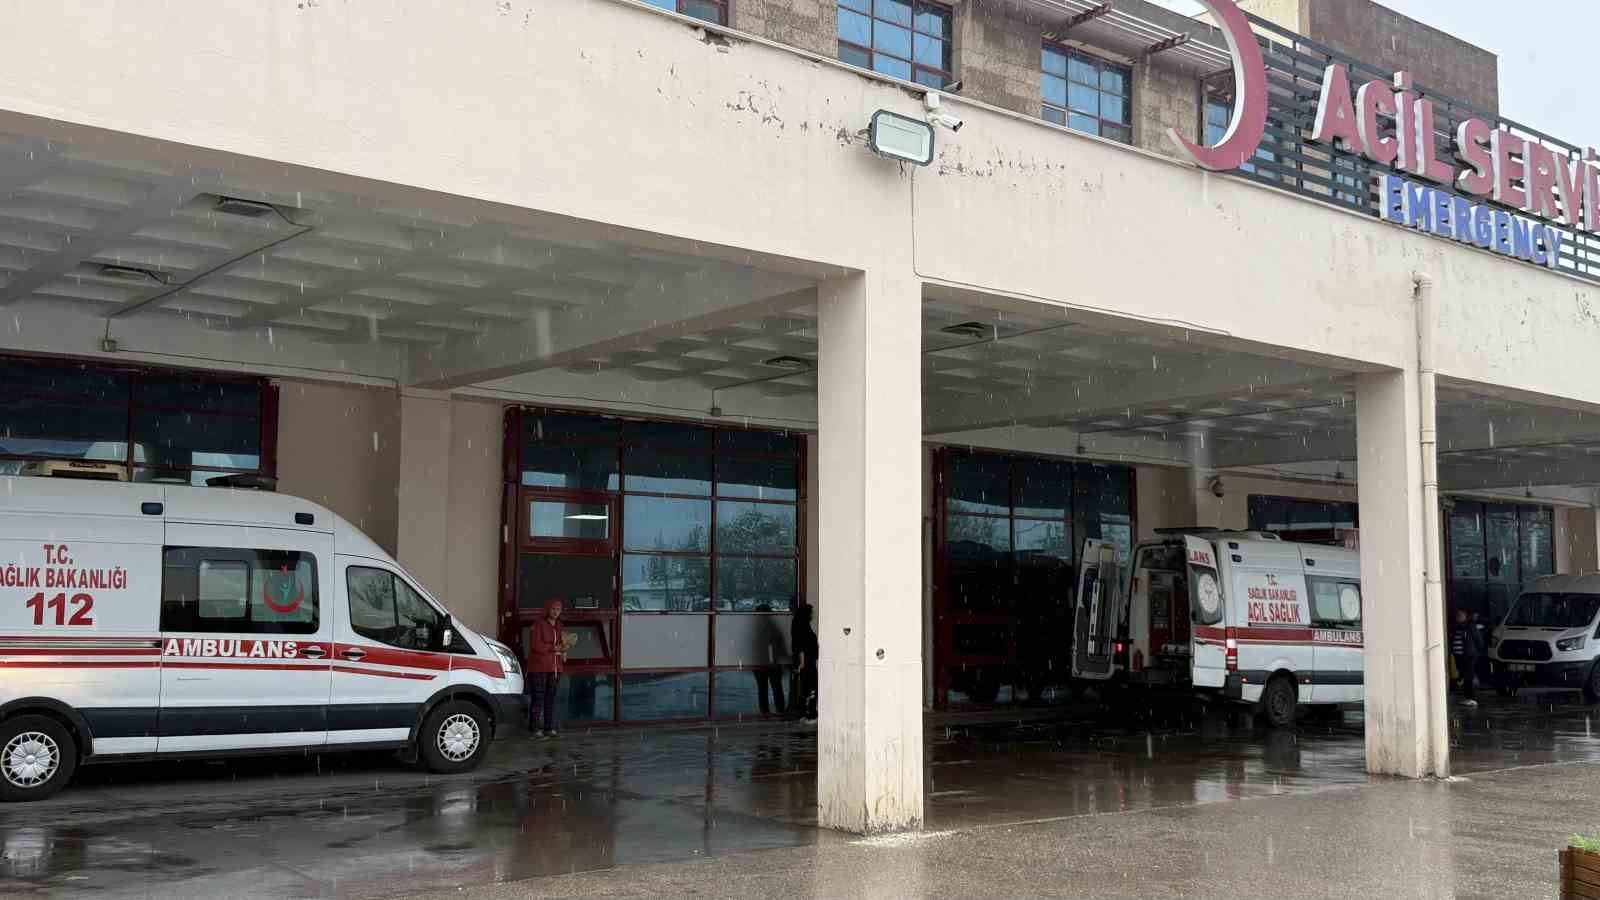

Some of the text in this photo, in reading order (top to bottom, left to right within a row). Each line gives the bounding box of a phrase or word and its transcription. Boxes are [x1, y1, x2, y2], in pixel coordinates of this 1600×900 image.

[1312, 64, 1455, 184] ACİL
[1379, 176, 1563, 269] EMERGENCY
[43, 544, 74, 565] T.C.
[45, 566, 127, 589] BAKANLIĞI
[26, 592, 94, 626] 112
[163, 638, 298, 658] AMBULANS
[1314, 630, 1362, 644] AMBULANS
